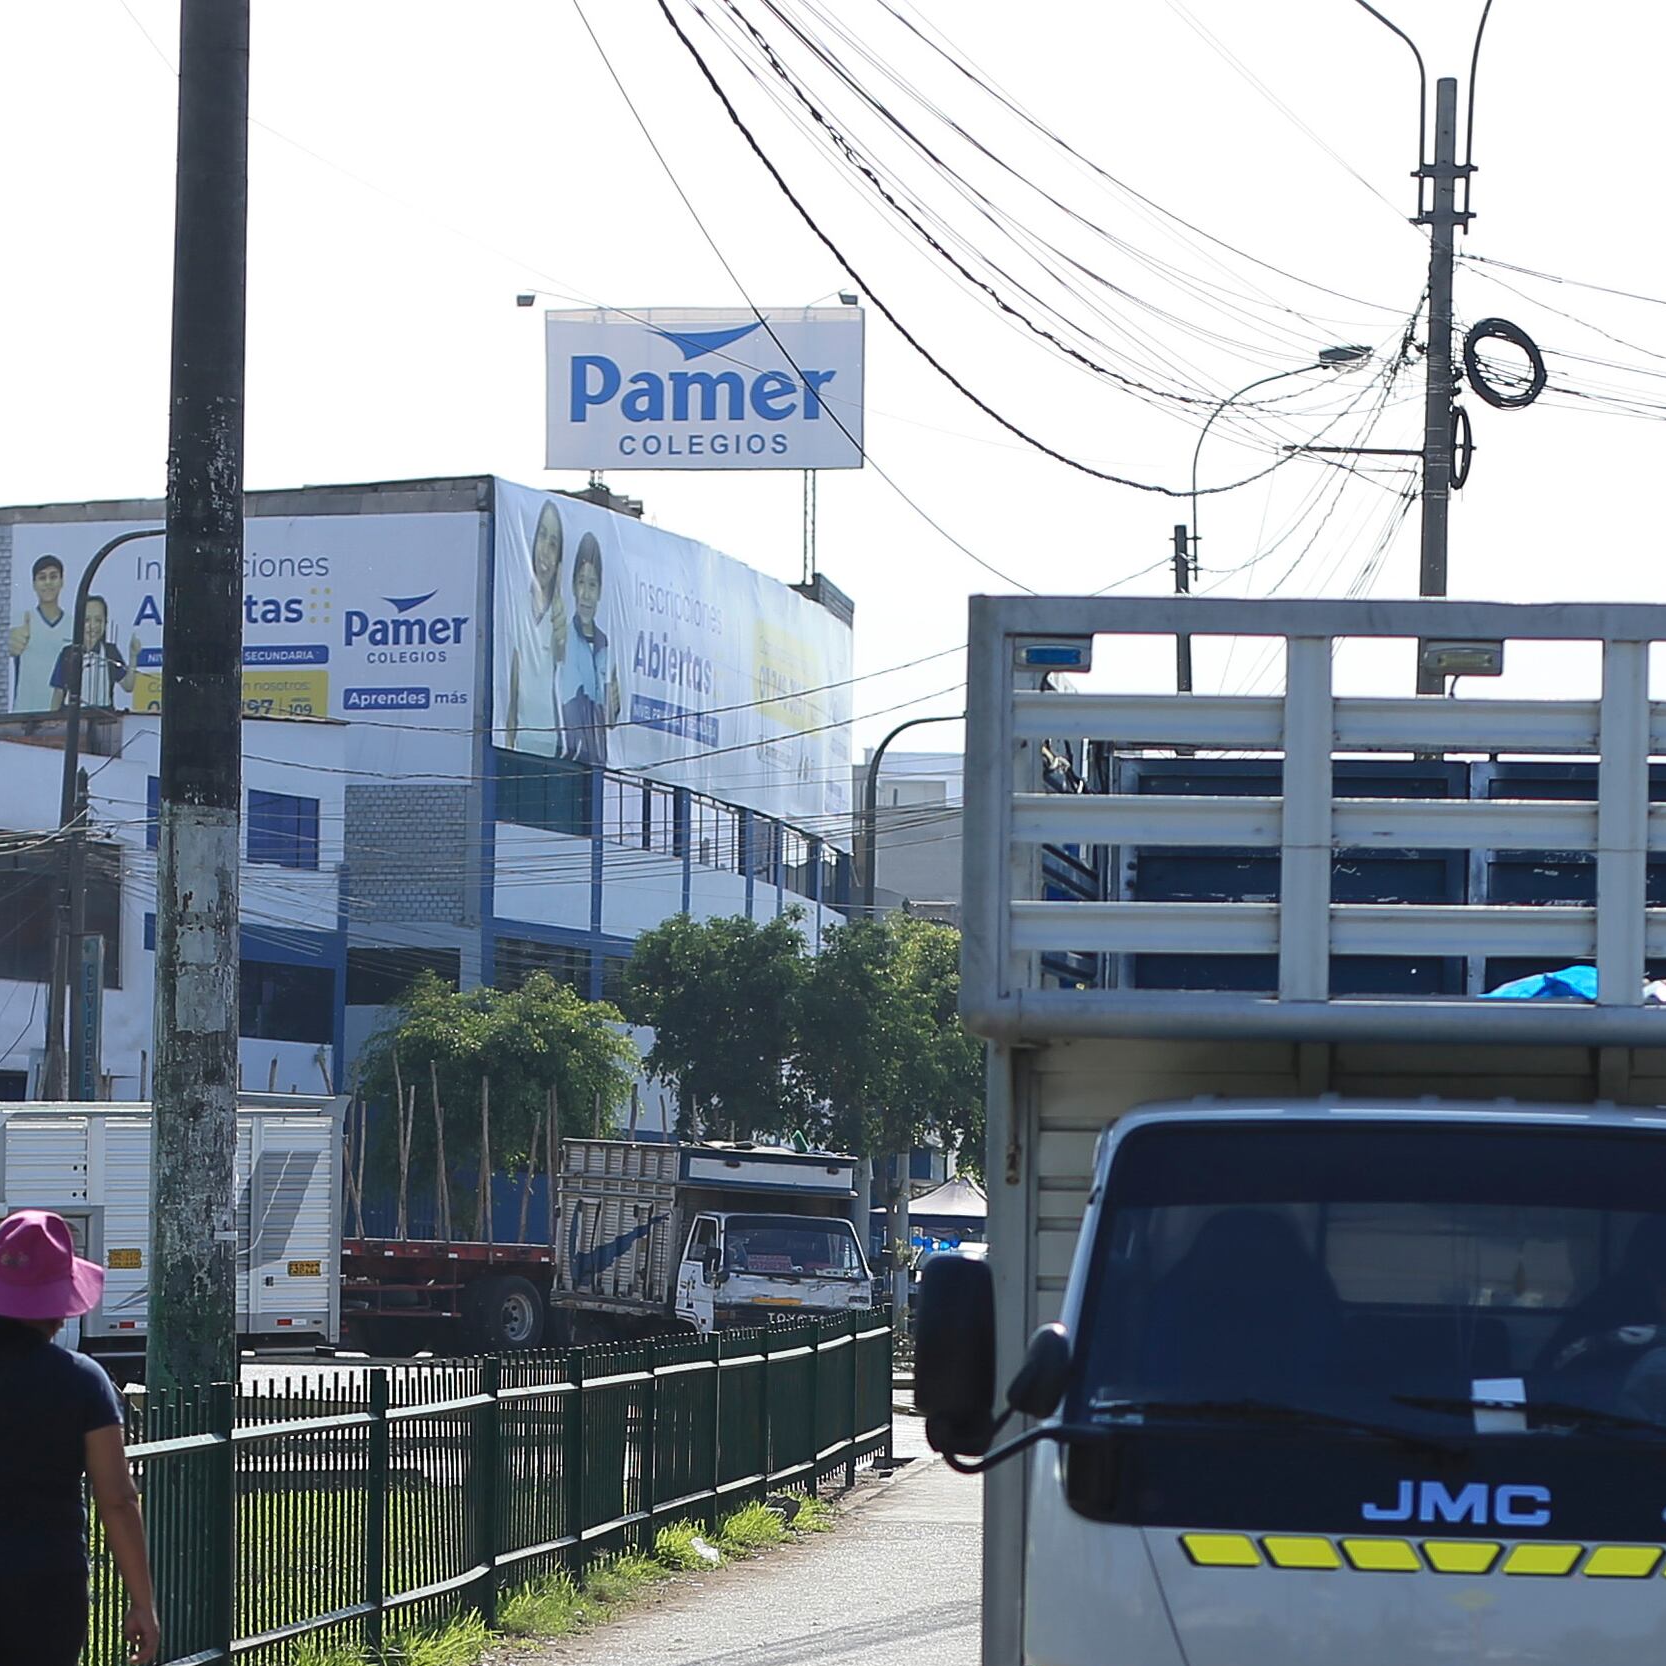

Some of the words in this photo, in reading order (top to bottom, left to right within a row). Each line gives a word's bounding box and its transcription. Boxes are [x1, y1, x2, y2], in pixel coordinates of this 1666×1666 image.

[569, 354, 837, 424] Pamer
[618, 433, 789, 456] COLEGIOS
[344, 610, 470, 647] Pamer
[244, 650, 314, 662] SECUNDARIA
[367, 651, 447, 664] COLEGIOS
[633, 630, 713, 695] Abiertas
[348, 691, 426, 708] Aprendes
[434, 690, 468, 704] más
[1361, 1480, 1552, 1527] JMC
